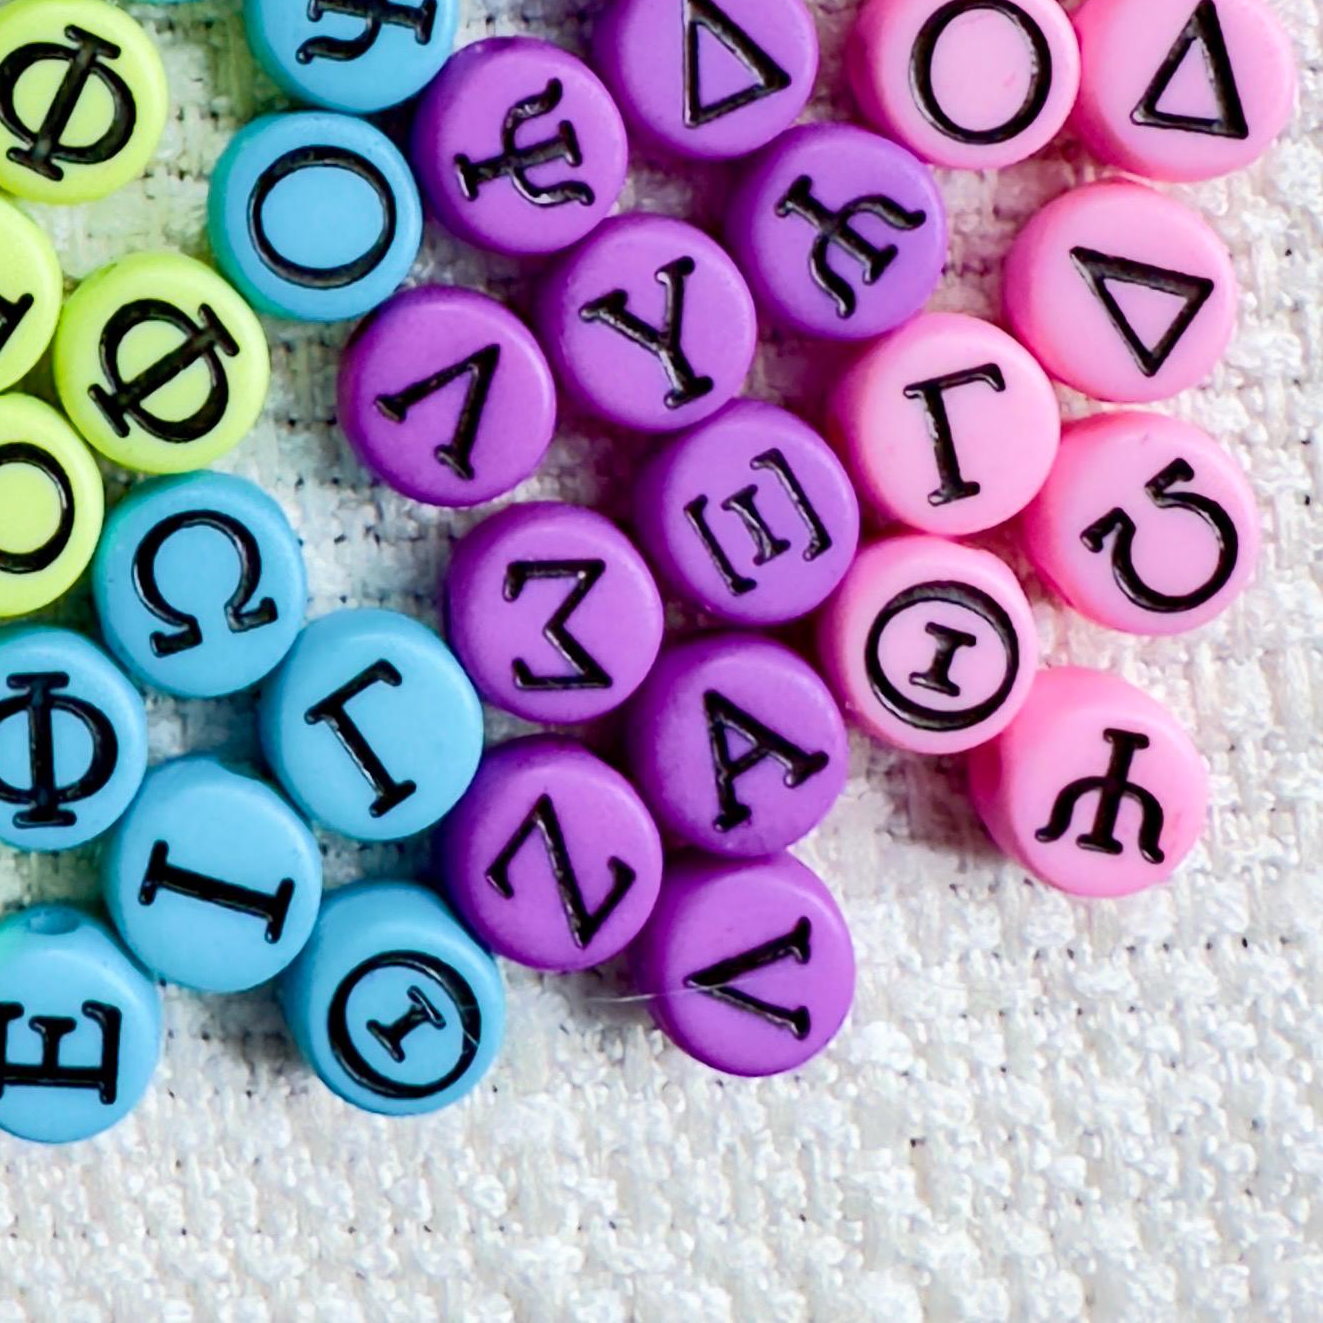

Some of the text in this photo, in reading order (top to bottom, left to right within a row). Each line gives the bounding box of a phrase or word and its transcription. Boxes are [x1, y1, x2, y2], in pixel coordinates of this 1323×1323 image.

[453, 78, 595, 208] Ψ
[776, 175, 926, 319] Ψ
[1070, 246, 1215, 378] Δ
[87, 298, 240, 444] Φ
[374, 344, 501, 481] Λ
[903, 363, 1006, 507] Γ
[132, 509, 278, 658] Ω
[683, 448, 832, 596] Ξ
[1080, 457, 1239, 614] Ω
[504, 559, 613, 692] Σ
[864, 580, 1020, 733] Θ
[304, 659, 417, 818] Γ
[1035, 728, 1165, 864] Ψ
[327, 950, 482, 1100] Θ
[683, 916, 811, 1040] Λ
